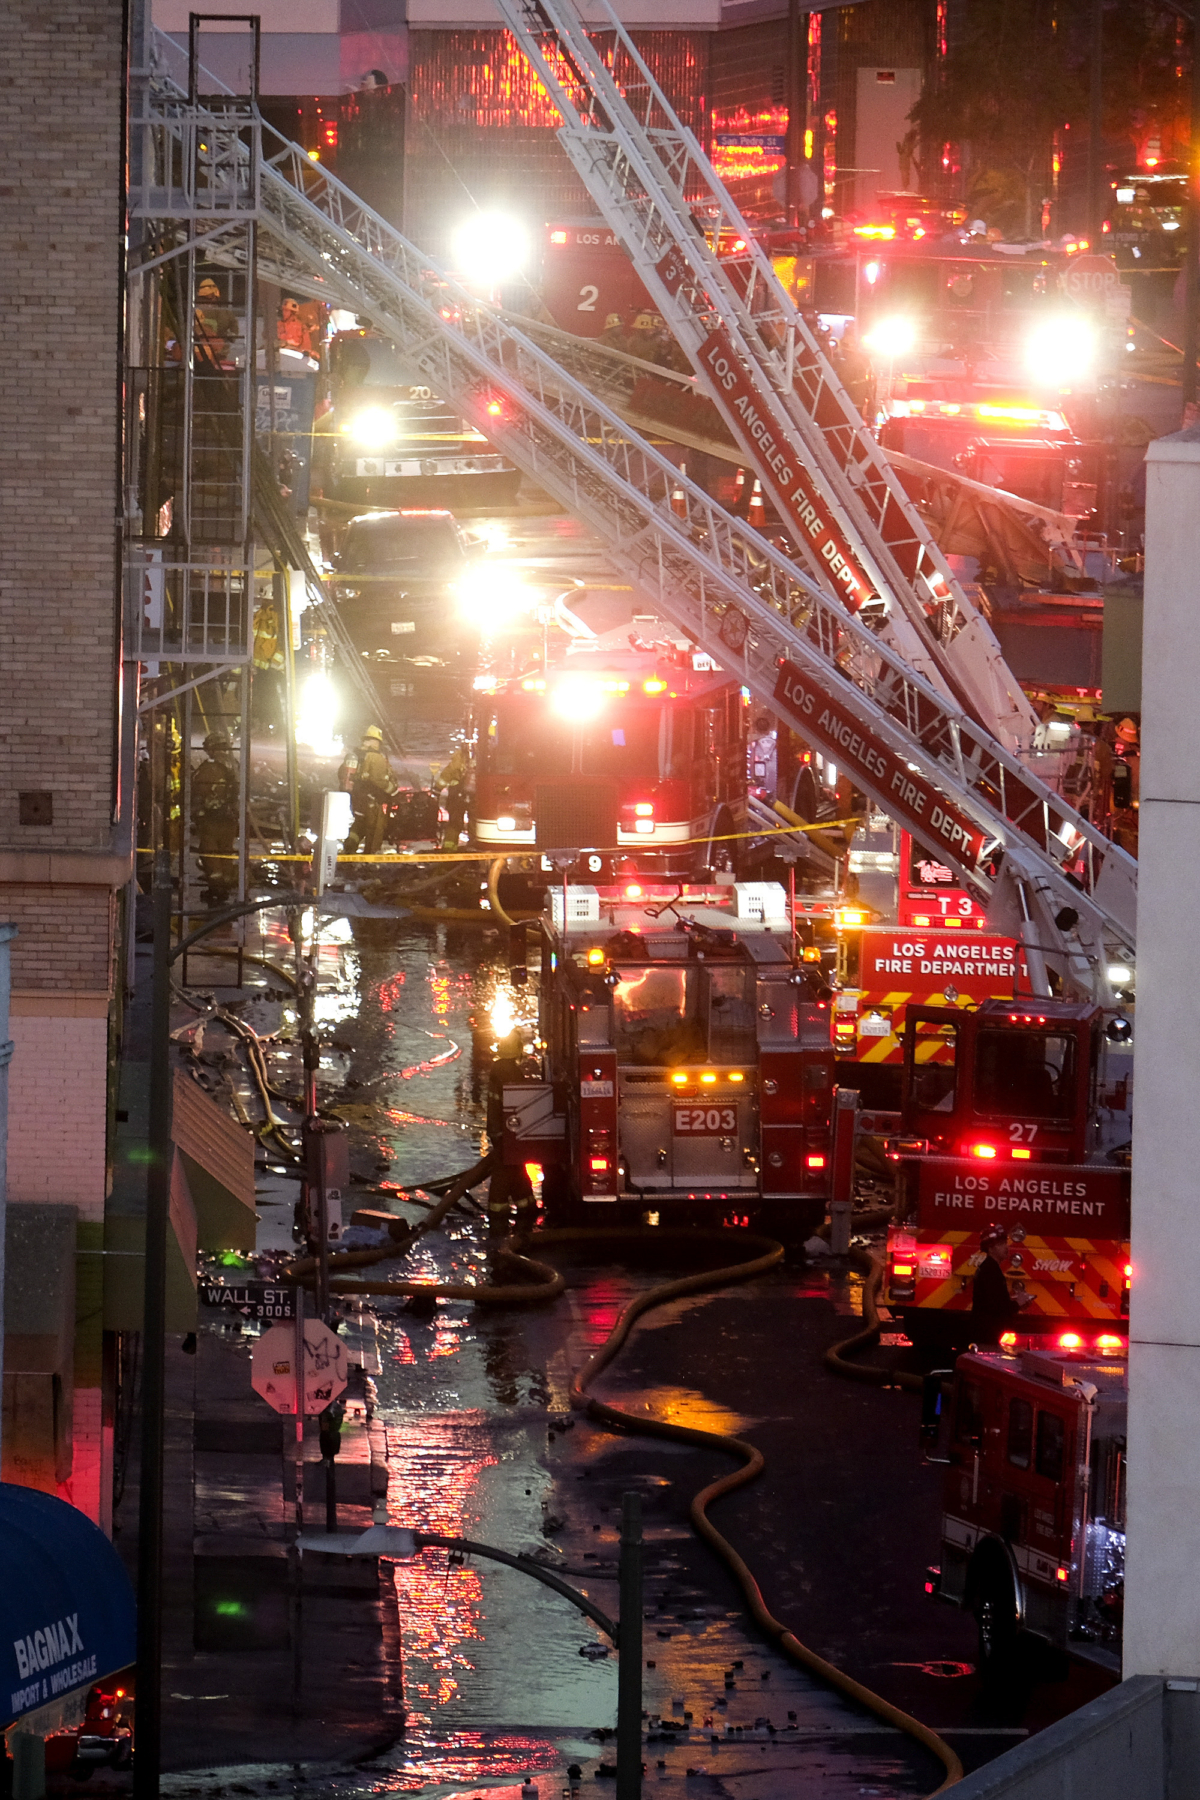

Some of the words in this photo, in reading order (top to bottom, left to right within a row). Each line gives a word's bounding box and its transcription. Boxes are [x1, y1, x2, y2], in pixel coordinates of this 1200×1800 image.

[721, 136, 738, 146] San
[740, 136, 764, 146] Pedro
[766, 137, 777, 146] St
[576, 234, 600, 245] LOS
[665, 265, 677, 280] 3
[668, 251, 687, 280] TRUCK
[1070, 271, 1116, 291] STOP
[577, 284, 599, 312] 2
[706, 346, 738, 391] LOS
[734, 395, 794, 487] ANGELES
[791, 487, 825, 539] FIRE
[820, 539, 861, 602] DEPT.
[783, 676, 817, 715] LOS
[817, 708, 888, 779] ANGELES
[890, 769, 928, 815] FIRE
[929, 806, 974, 858] DEPT.
[588, 855, 602, 872] 9
[937, 897, 952, 915] T
[958, 897, 973, 916] 3
[892, 943, 926, 957] LOS
[933, 944, 1014, 960] ANGELES
[874, 958, 912, 974] FIRE
[675, 1109, 736, 1131] E203
[1008, 1122, 1039, 1144] 27
[954, 1175, 990, 1192] LOS
[999, 1178, 1087, 1198] ANGELES
[934, 1192, 975, 1209] FIRE
[984, 1195, 1106, 1217] DEPARTMENT
[1032, 1258, 1074, 1273] SHOW
[207, 1289, 257, 1304] WALL
[263, 1289, 291, 1305] ST.
[13, 1612, 85, 1680] BAGMAX
[10, 1681, 40, 1714] IMPORT
[42, 1678, 49, 1699] &
[50, 1654, 98, 1695] WHOLESALE
